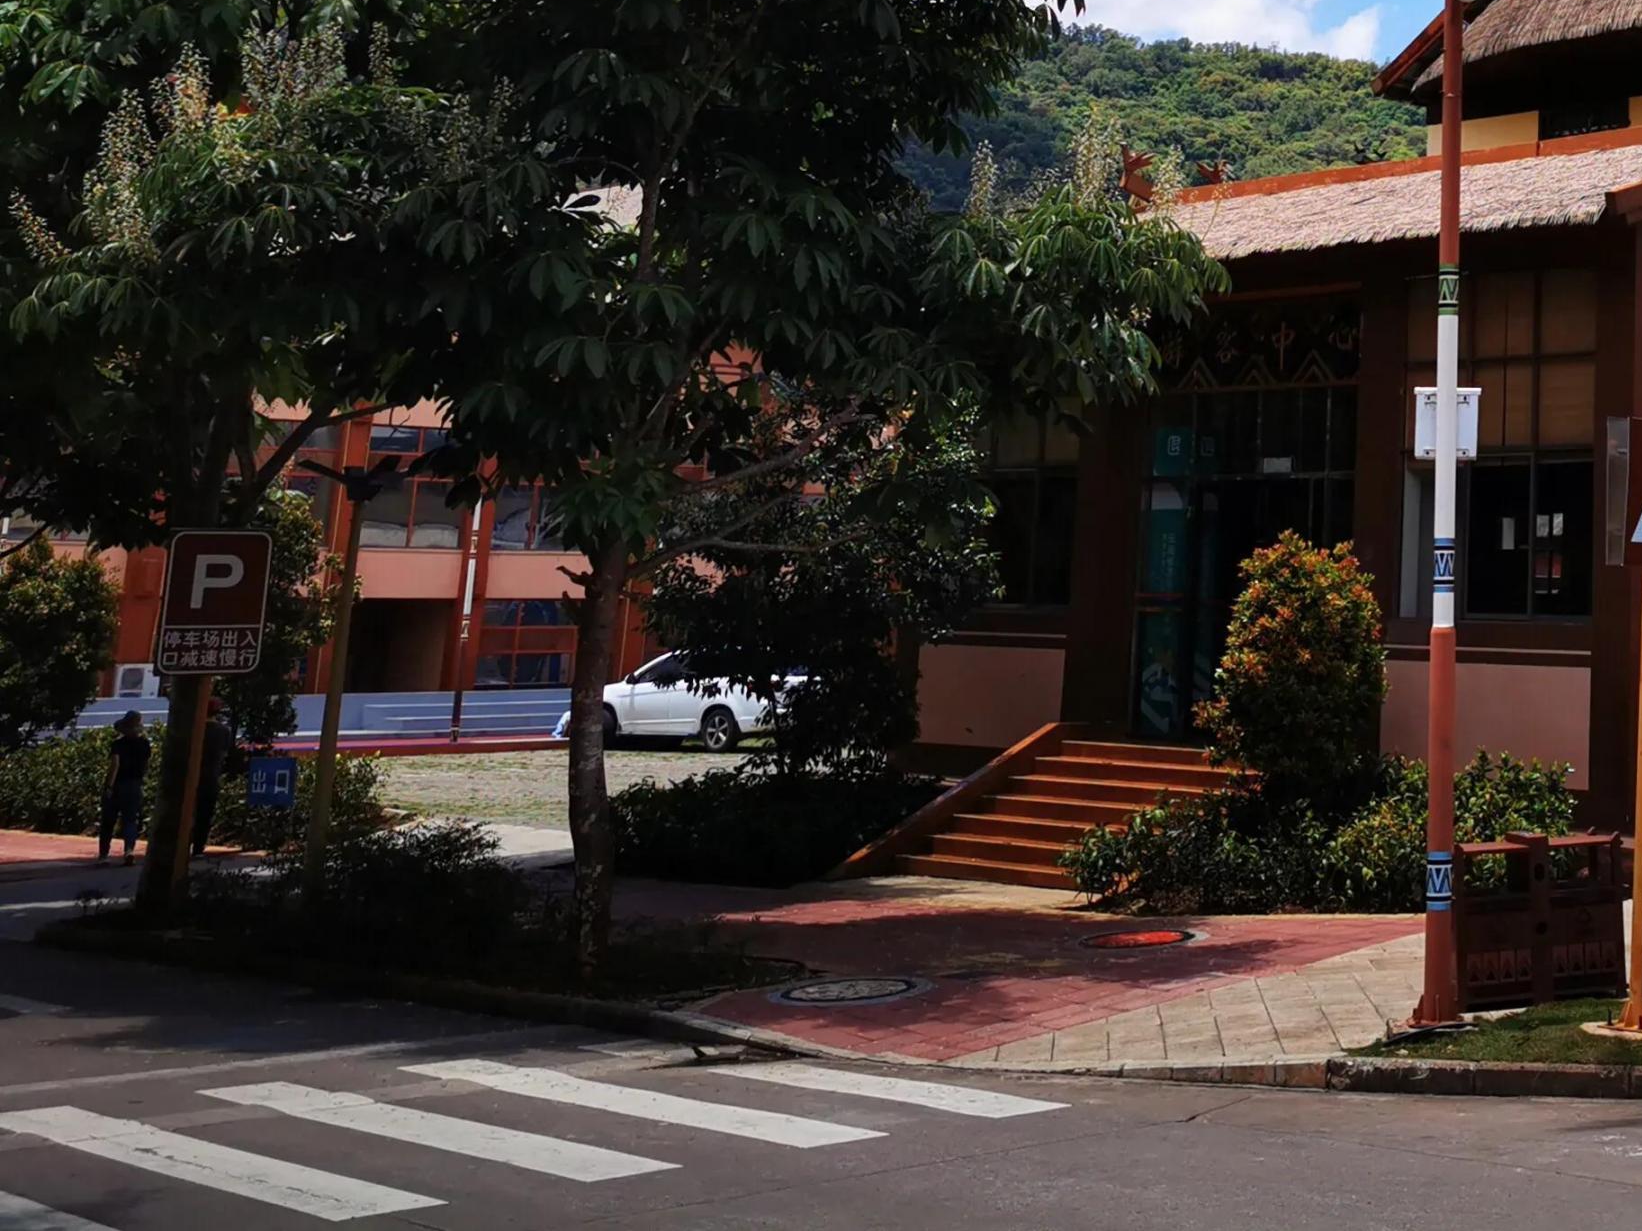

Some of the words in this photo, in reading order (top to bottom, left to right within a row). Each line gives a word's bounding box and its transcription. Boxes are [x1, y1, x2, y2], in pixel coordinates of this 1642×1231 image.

[190, 554, 245, 610] P
[163, 630, 257, 649] 停车场出入
[162, 649, 257, 668] 口减速慢行
[251, 768, 290, 795] 出口
